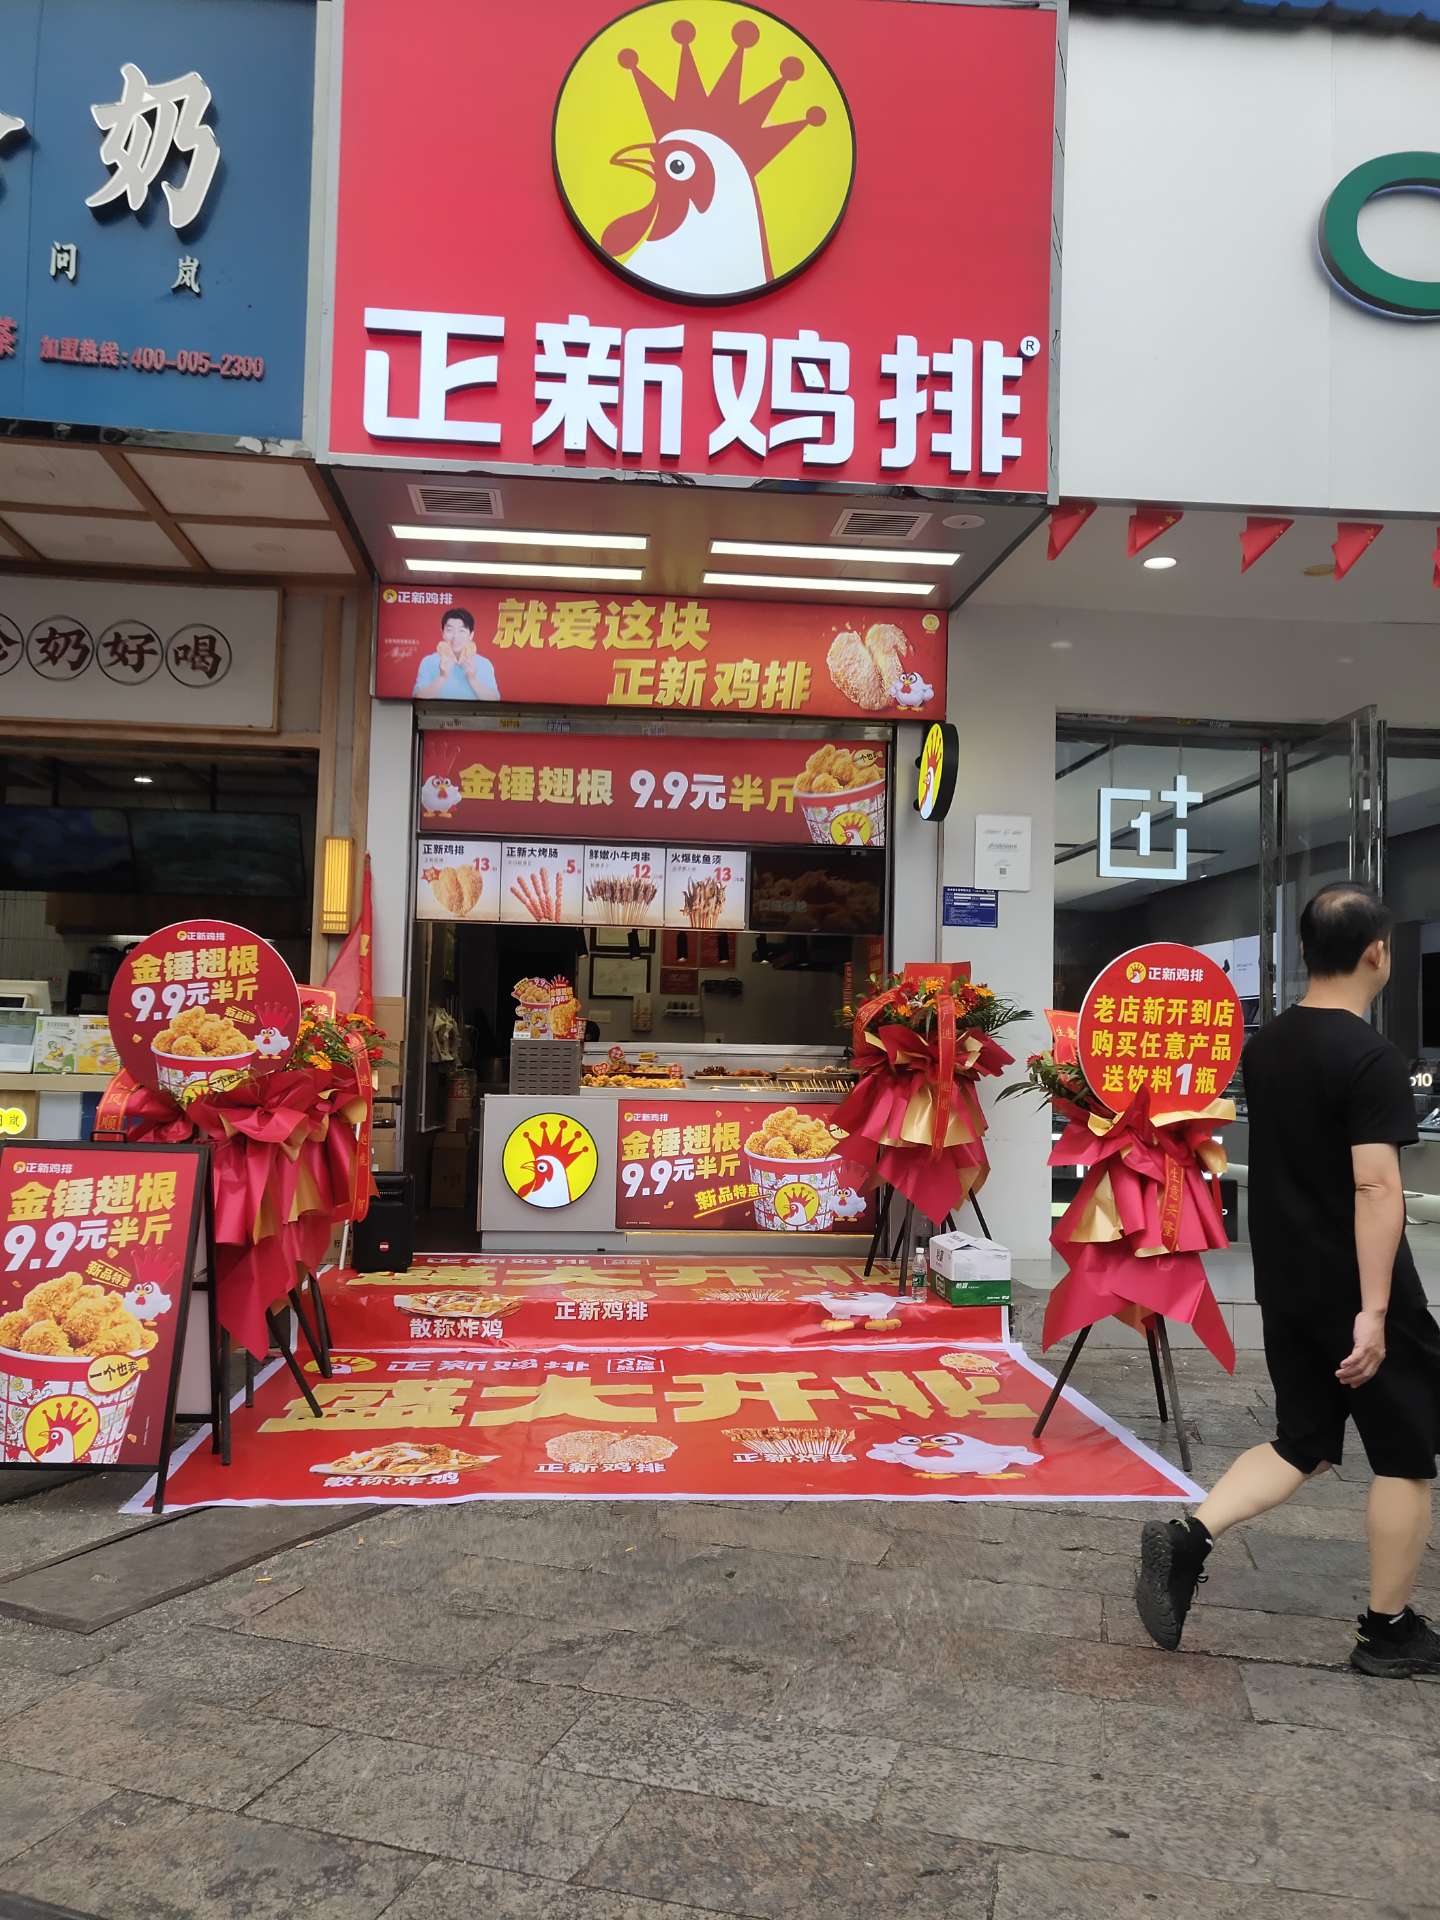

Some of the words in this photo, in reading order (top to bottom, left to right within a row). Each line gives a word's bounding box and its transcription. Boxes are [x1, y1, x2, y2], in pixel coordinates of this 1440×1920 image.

[85, 63, 221, 229] 奶
[50, 241, 77, 280] 问
[171, 255, 200, 294] 岚
[362, 306, 1023, 475] 正新鸡排
[398, 591, 454, 605] 正新鸡排
[492, 599, 712, 650] 就爱这块
[606, 658, 812, 710] 正新鸡排
[458, 764, 614, 806] 金锤翅根
[629, 768, 797, 814] 9.9元半斤
[422, 844, 465, 856] 正新鸡排
[506, 846, 559, 858] 正新大烤肠
[588, 849, 651, 862] 鲜嫩小牛肉串
[670, 853, 722, 865] 火爆鱿鱼须
[473, 857, 490, 872] 13
[566, 859, 576, 874] 5
[632, 864, 651, 879] 12
[713, 867, 732, 881] 13
[130, 945, 260, 985] 金锤翅根
[1148, 967, 1204, 983] 正新鸡排
[130, 977, 259, 1022] 9.9元半斤
[1093, 994, 1235, 1027] 老店新开到店
[1090, 1029, 1232, 1061] 购买任意产品
[1101, 1063, 1218, 1096] 送饮料1瓶
[633, 1113, 669, 1122] 正新鸡排
[622, 1121, 742, 1161] 金锤翅根
[25, 1162, 73, 1174] 正新鸡排
[621, 1153, 741, 1198] 9.9元半斤
[7, 1172, 177, 1222] 金锤翅根
[694, 1183, 760, 1211] 新品特惠
[4, 1214, 173, 1272] 9.9元半斤
[554, 1301, 649, 1321] 正新鸡排
[409, 1318, 504, 1340] 散称炸鸡
[387, 1359, 590, 1372] 正新鸡排
[256, 1372, 1039, 1433] 盛大开业
[323, 1472, 461, 1488] 散称炸鸡
[535, 1462, 667, 1474] 正新鸡排
